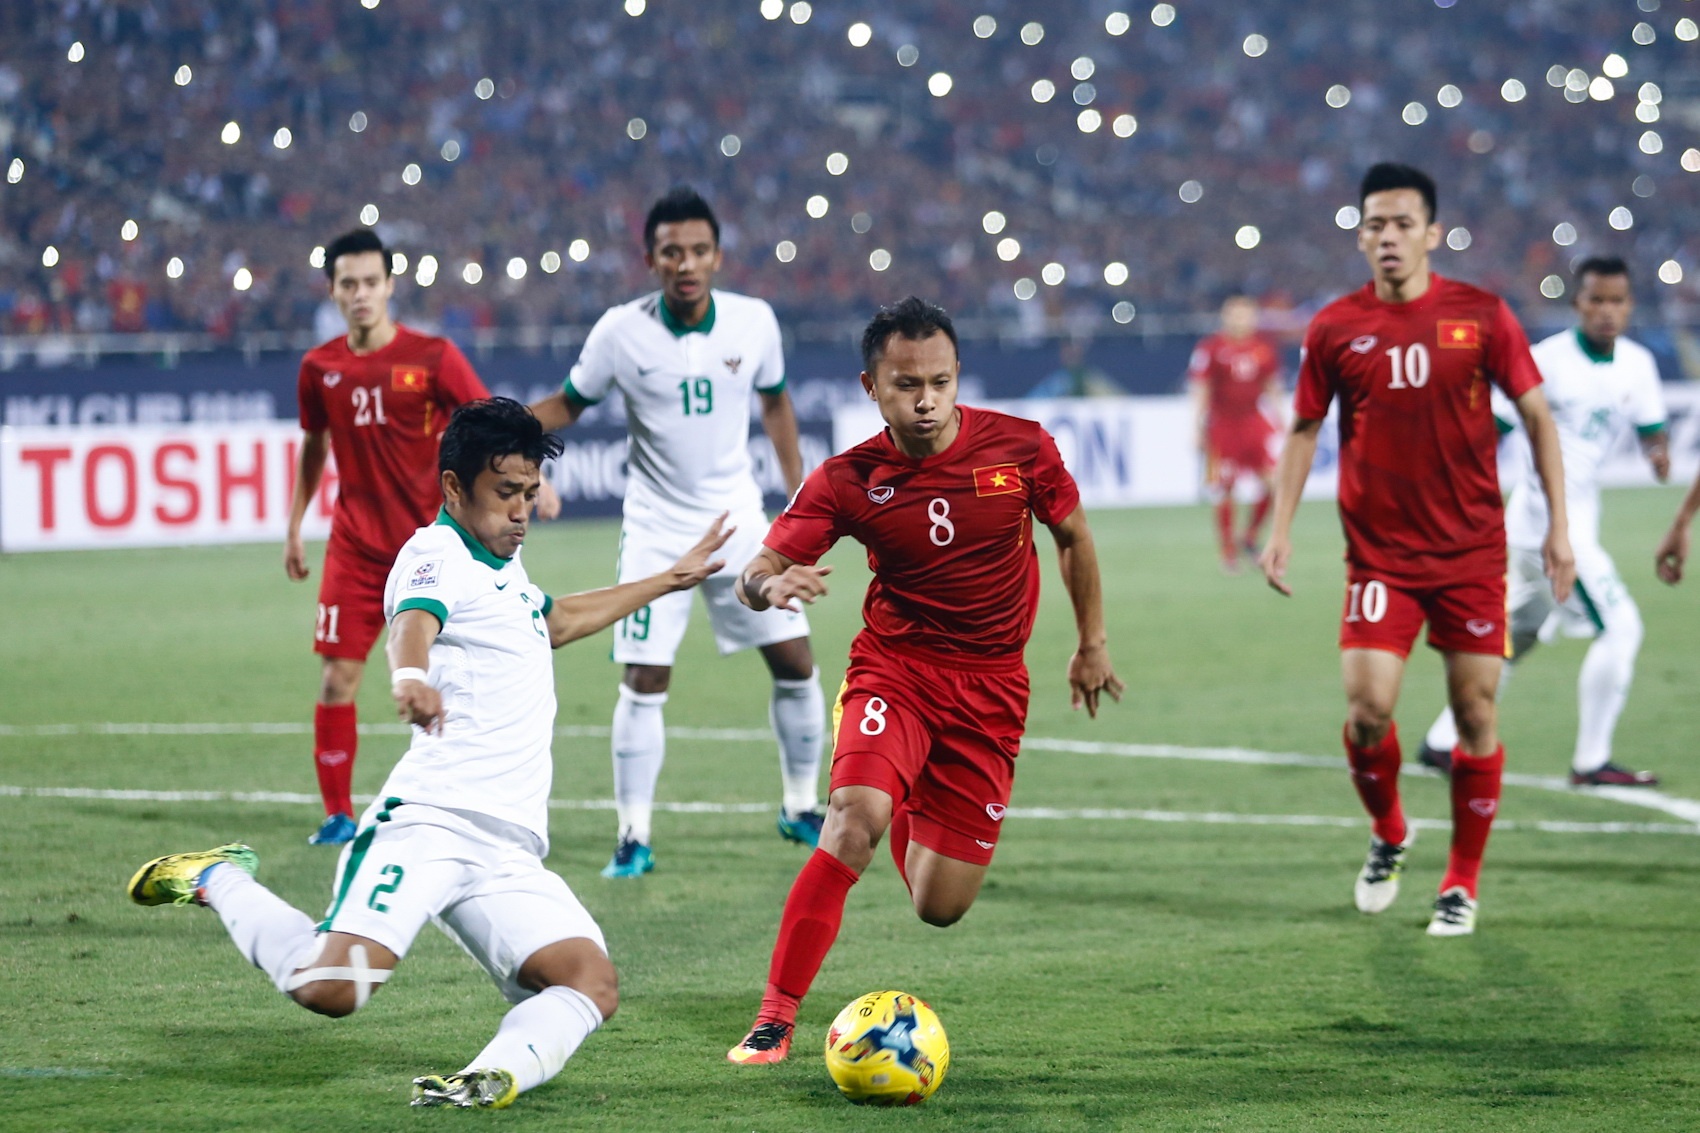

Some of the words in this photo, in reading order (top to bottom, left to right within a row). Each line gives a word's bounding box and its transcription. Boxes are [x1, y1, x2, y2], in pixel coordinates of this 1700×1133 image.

[1385, 342, 1430, 389] 10
[351, 385, 387, 427] 21
[678, 377, 712, 415] 19
[928, 497, 955, 546] 8
[622, 605, 651, 640] 19
[1345, 579, 1388, 623] 10
[859, 696, 888, 736] 8
[367, 863, 404, 914] 2
